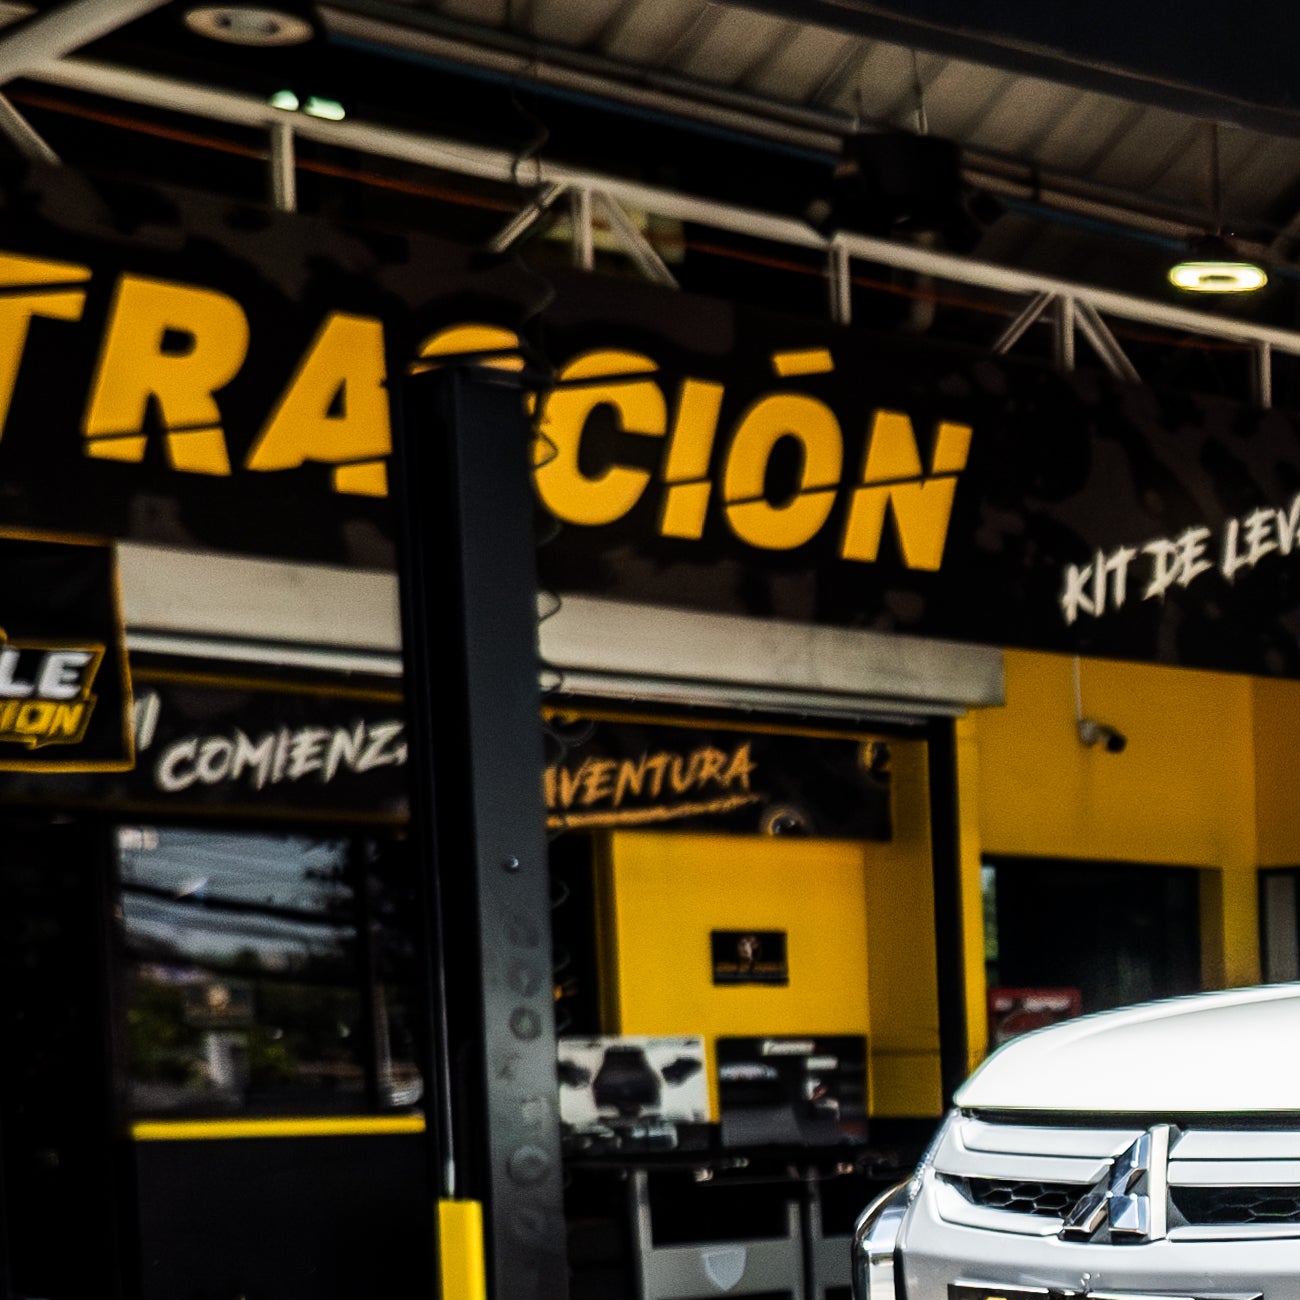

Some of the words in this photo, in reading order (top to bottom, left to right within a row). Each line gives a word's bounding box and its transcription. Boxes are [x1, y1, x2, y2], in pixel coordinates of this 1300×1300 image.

[1062, 546, 1136, 626] KIT
[1142, 526, 1213, 601] DE
[158, 720, 407, 792] COMIENZ
